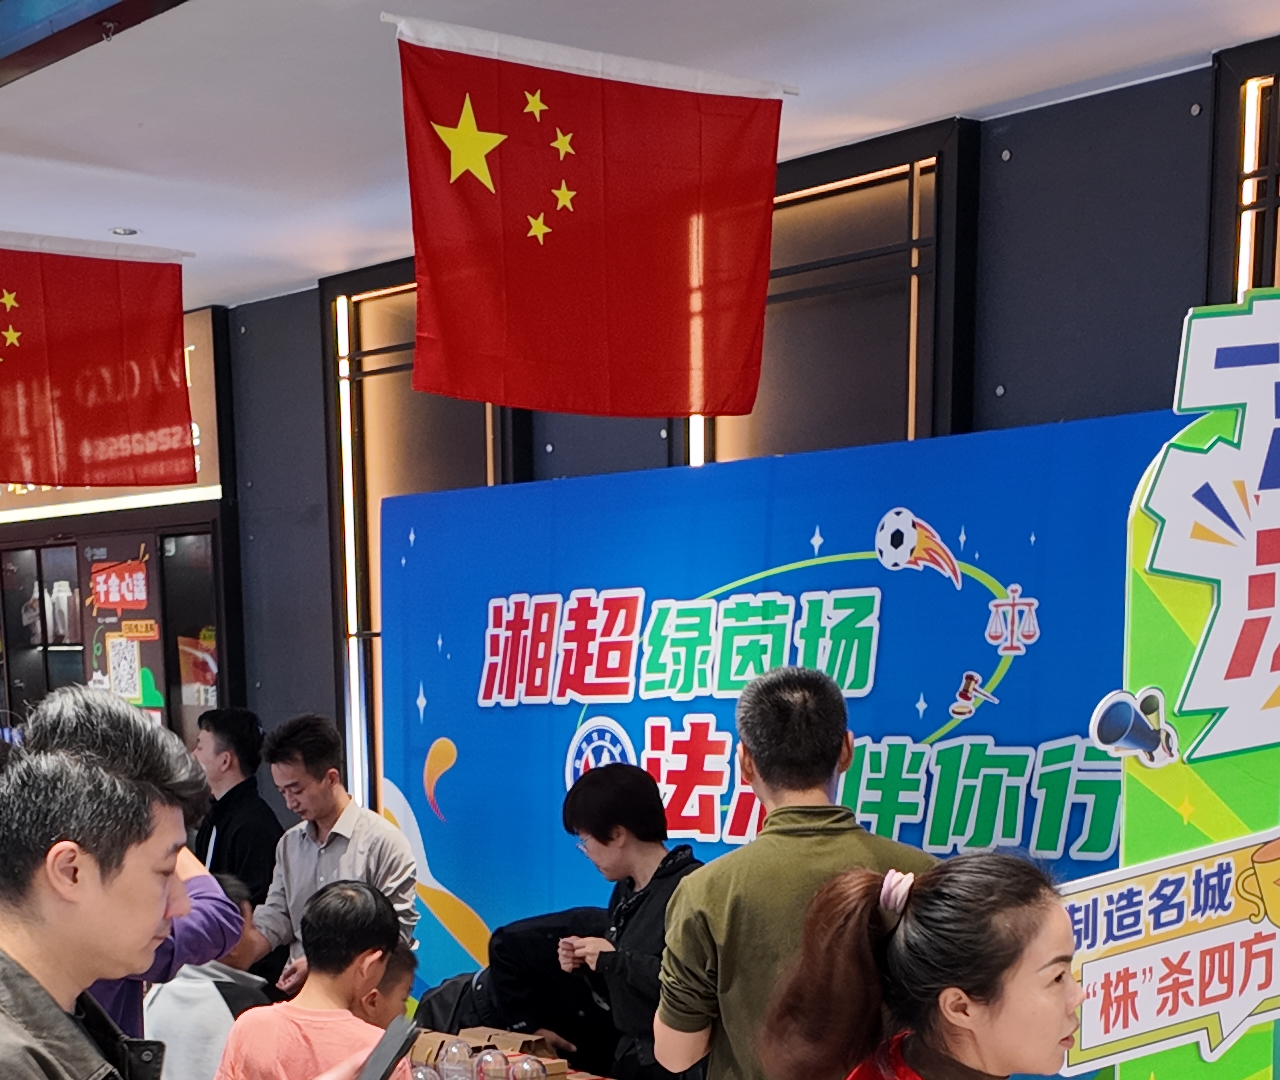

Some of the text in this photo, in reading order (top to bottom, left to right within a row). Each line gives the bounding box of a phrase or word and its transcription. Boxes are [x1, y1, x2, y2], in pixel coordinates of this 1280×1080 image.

[480, 589, 880, 705] 湘超绿茵场
[642, 716, 1122, 862] 法伴你行
